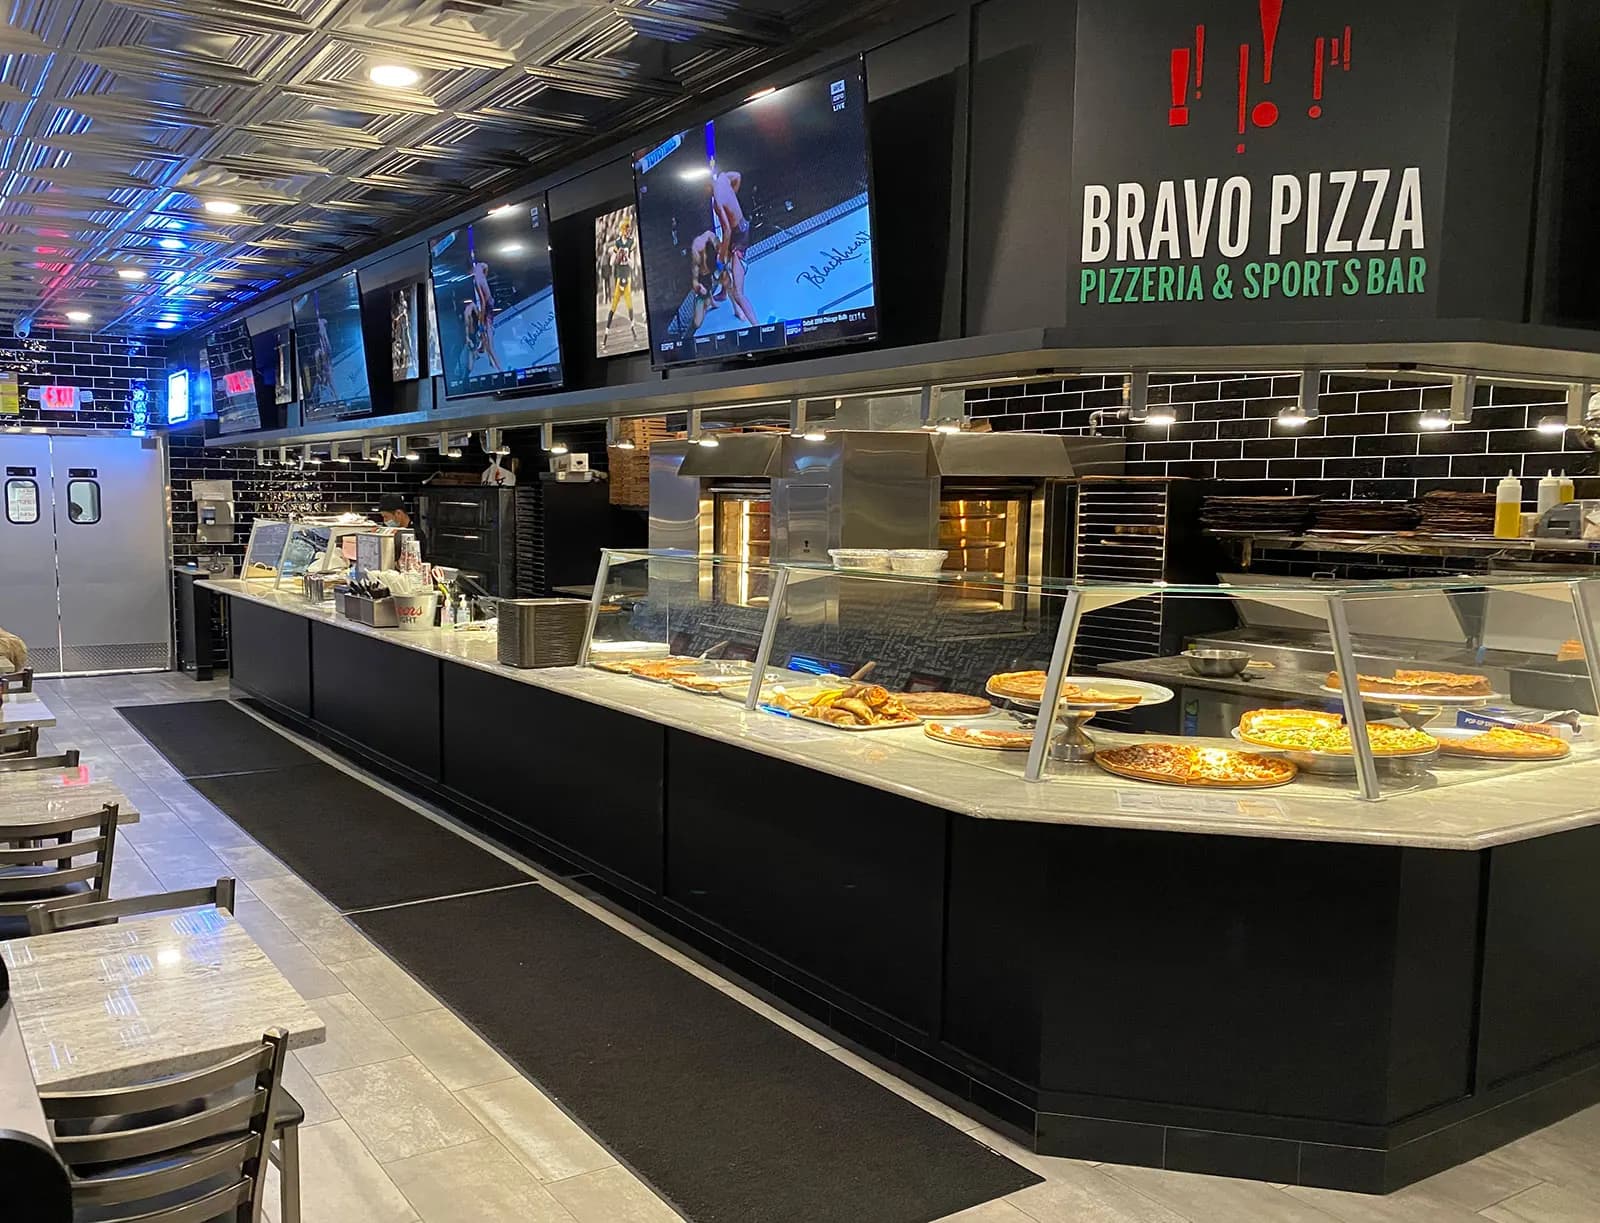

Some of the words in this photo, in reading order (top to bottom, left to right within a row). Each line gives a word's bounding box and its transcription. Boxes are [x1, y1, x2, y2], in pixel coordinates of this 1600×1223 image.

[1080, 175, 1252, 263] BRAVO
[1268, 167, 1425, 256] PIZZA
[1080, 265, 1204, 304] PIZZERIA
[1212, 263, 1233, 299] &
